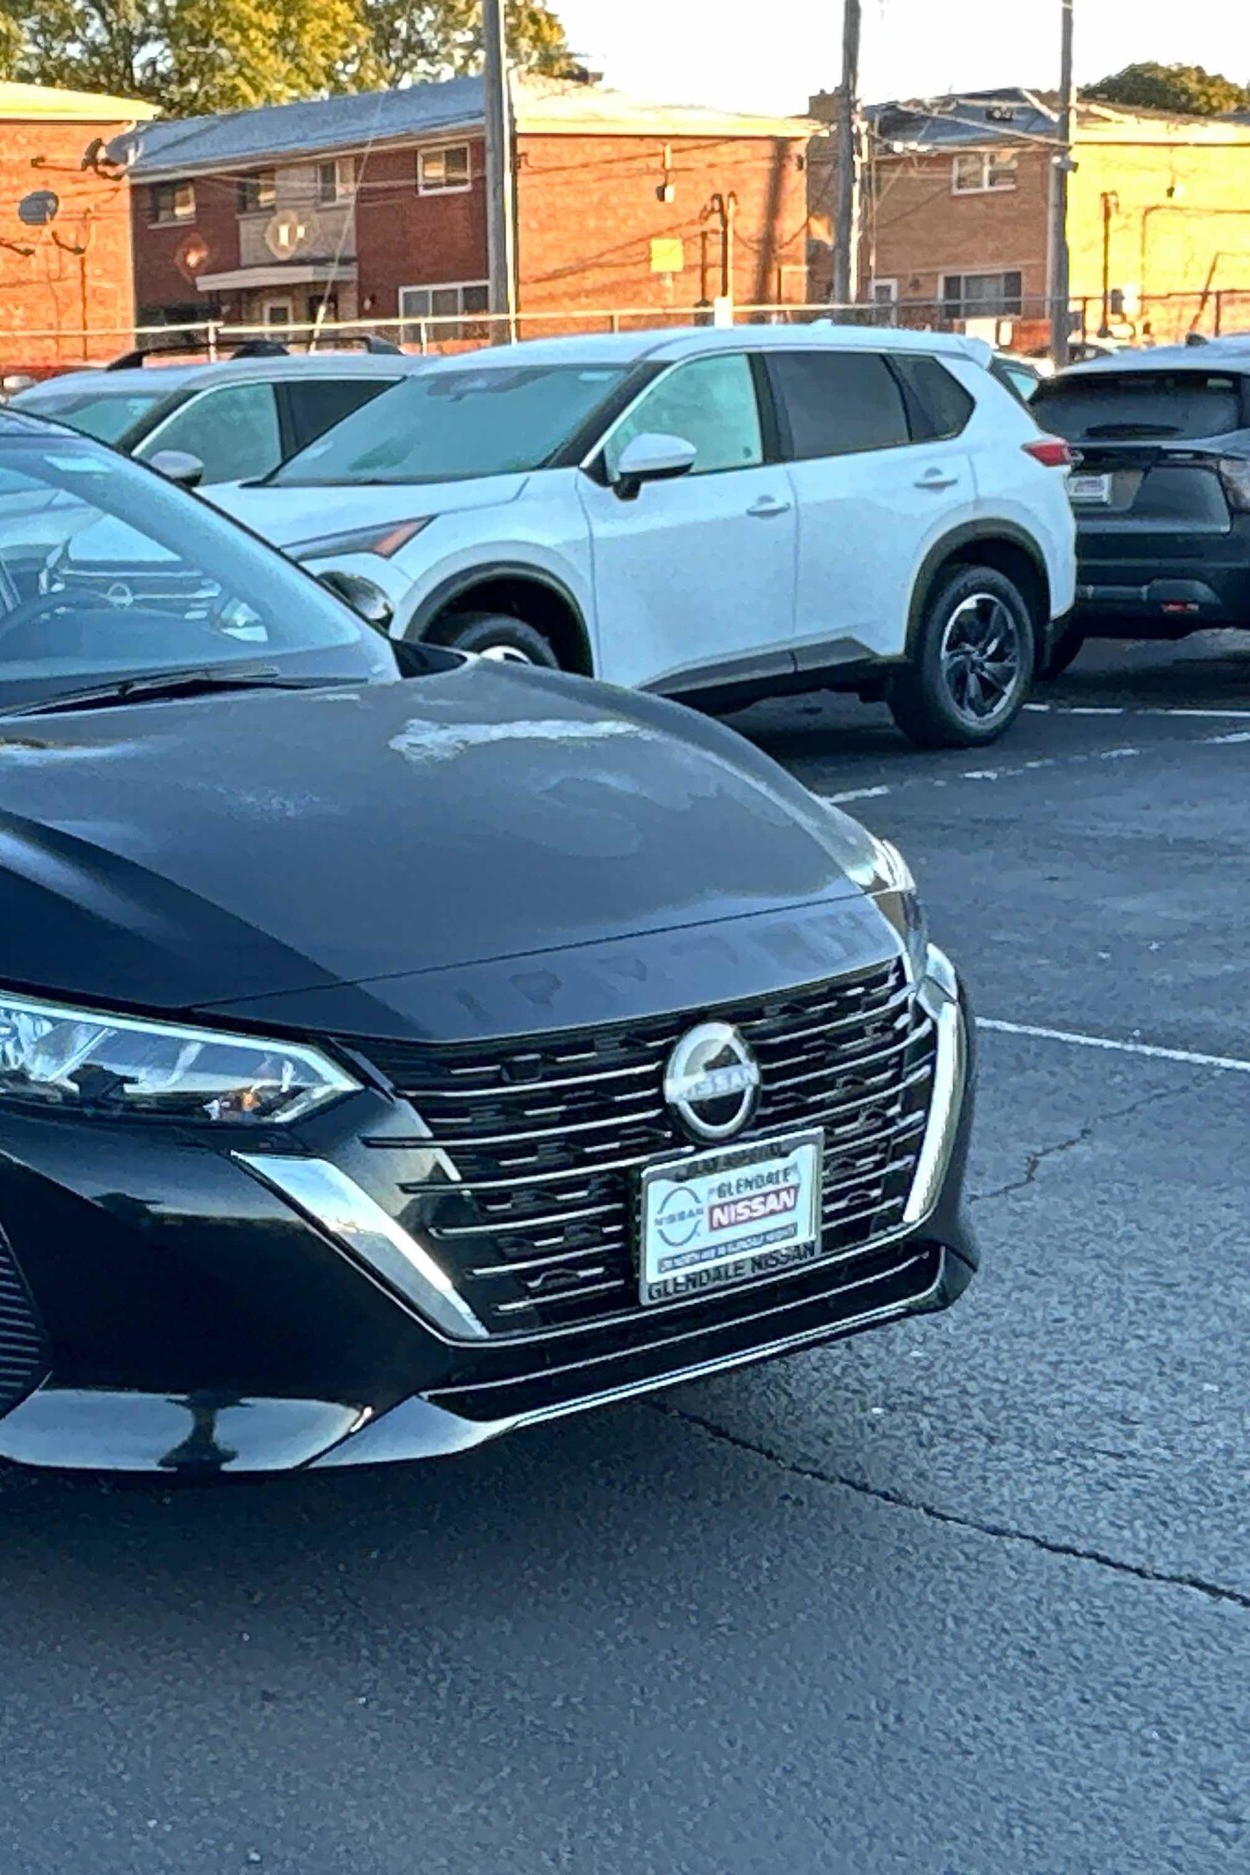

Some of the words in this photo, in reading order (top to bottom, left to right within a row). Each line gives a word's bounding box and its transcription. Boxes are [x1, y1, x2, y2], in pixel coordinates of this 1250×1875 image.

[717, 1167, 791, 1197] GLENDALE
[654, 1206, 704, 1226] NISSAN
[711, 1188, 795, 1228] NISSAN
[647, 1263, 745, 1301] GLENDALE
[751, 1241, 815, 1274] NISSAN
